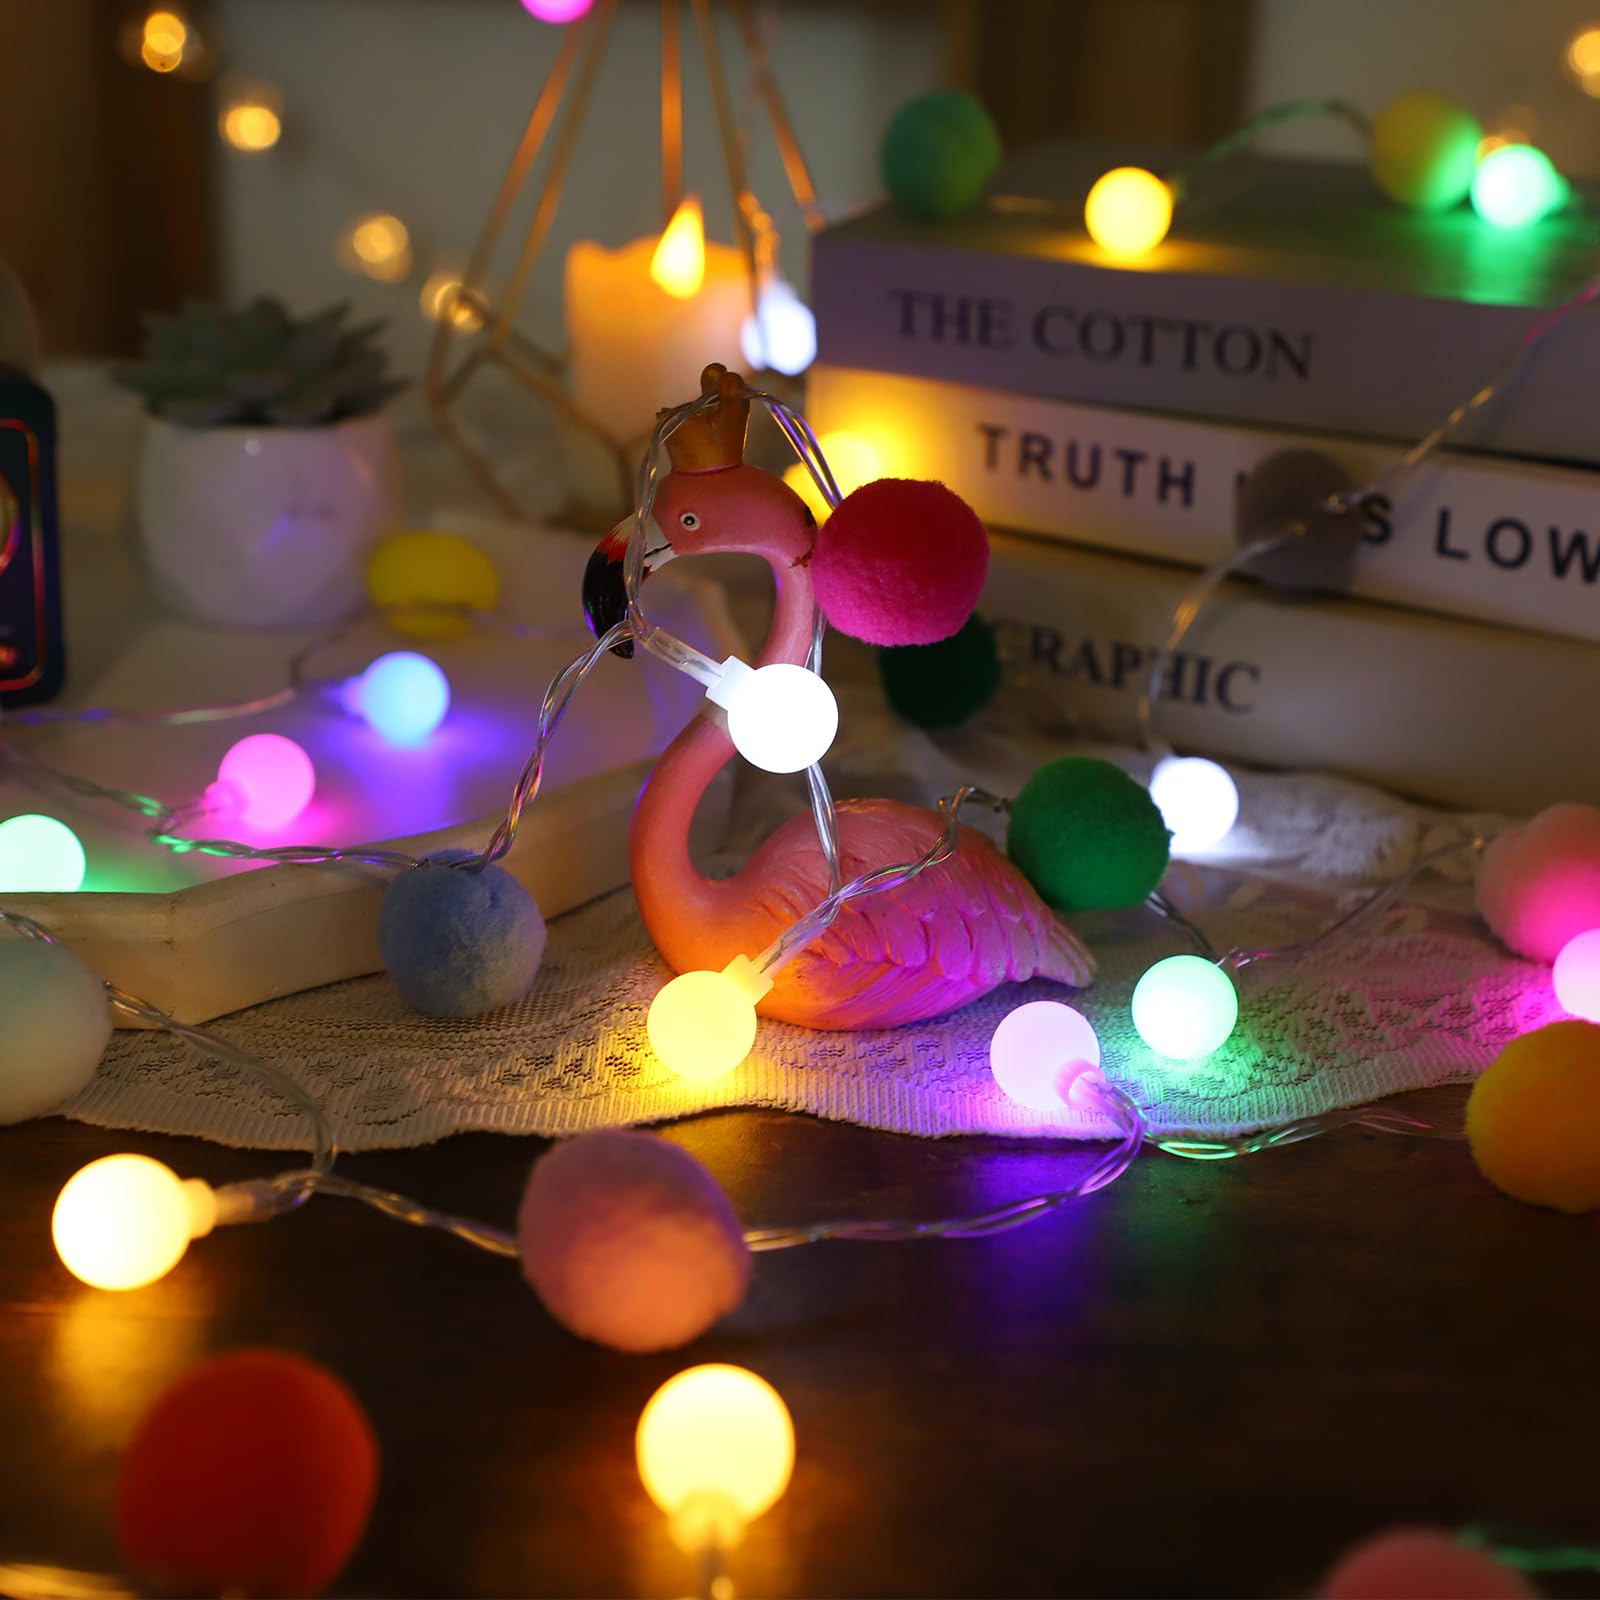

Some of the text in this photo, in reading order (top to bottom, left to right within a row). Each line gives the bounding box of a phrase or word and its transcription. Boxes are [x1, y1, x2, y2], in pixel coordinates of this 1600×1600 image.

[886, 288, 1315, 381] THE COTTON
[978, 422, 1195, 508] TRUTH
